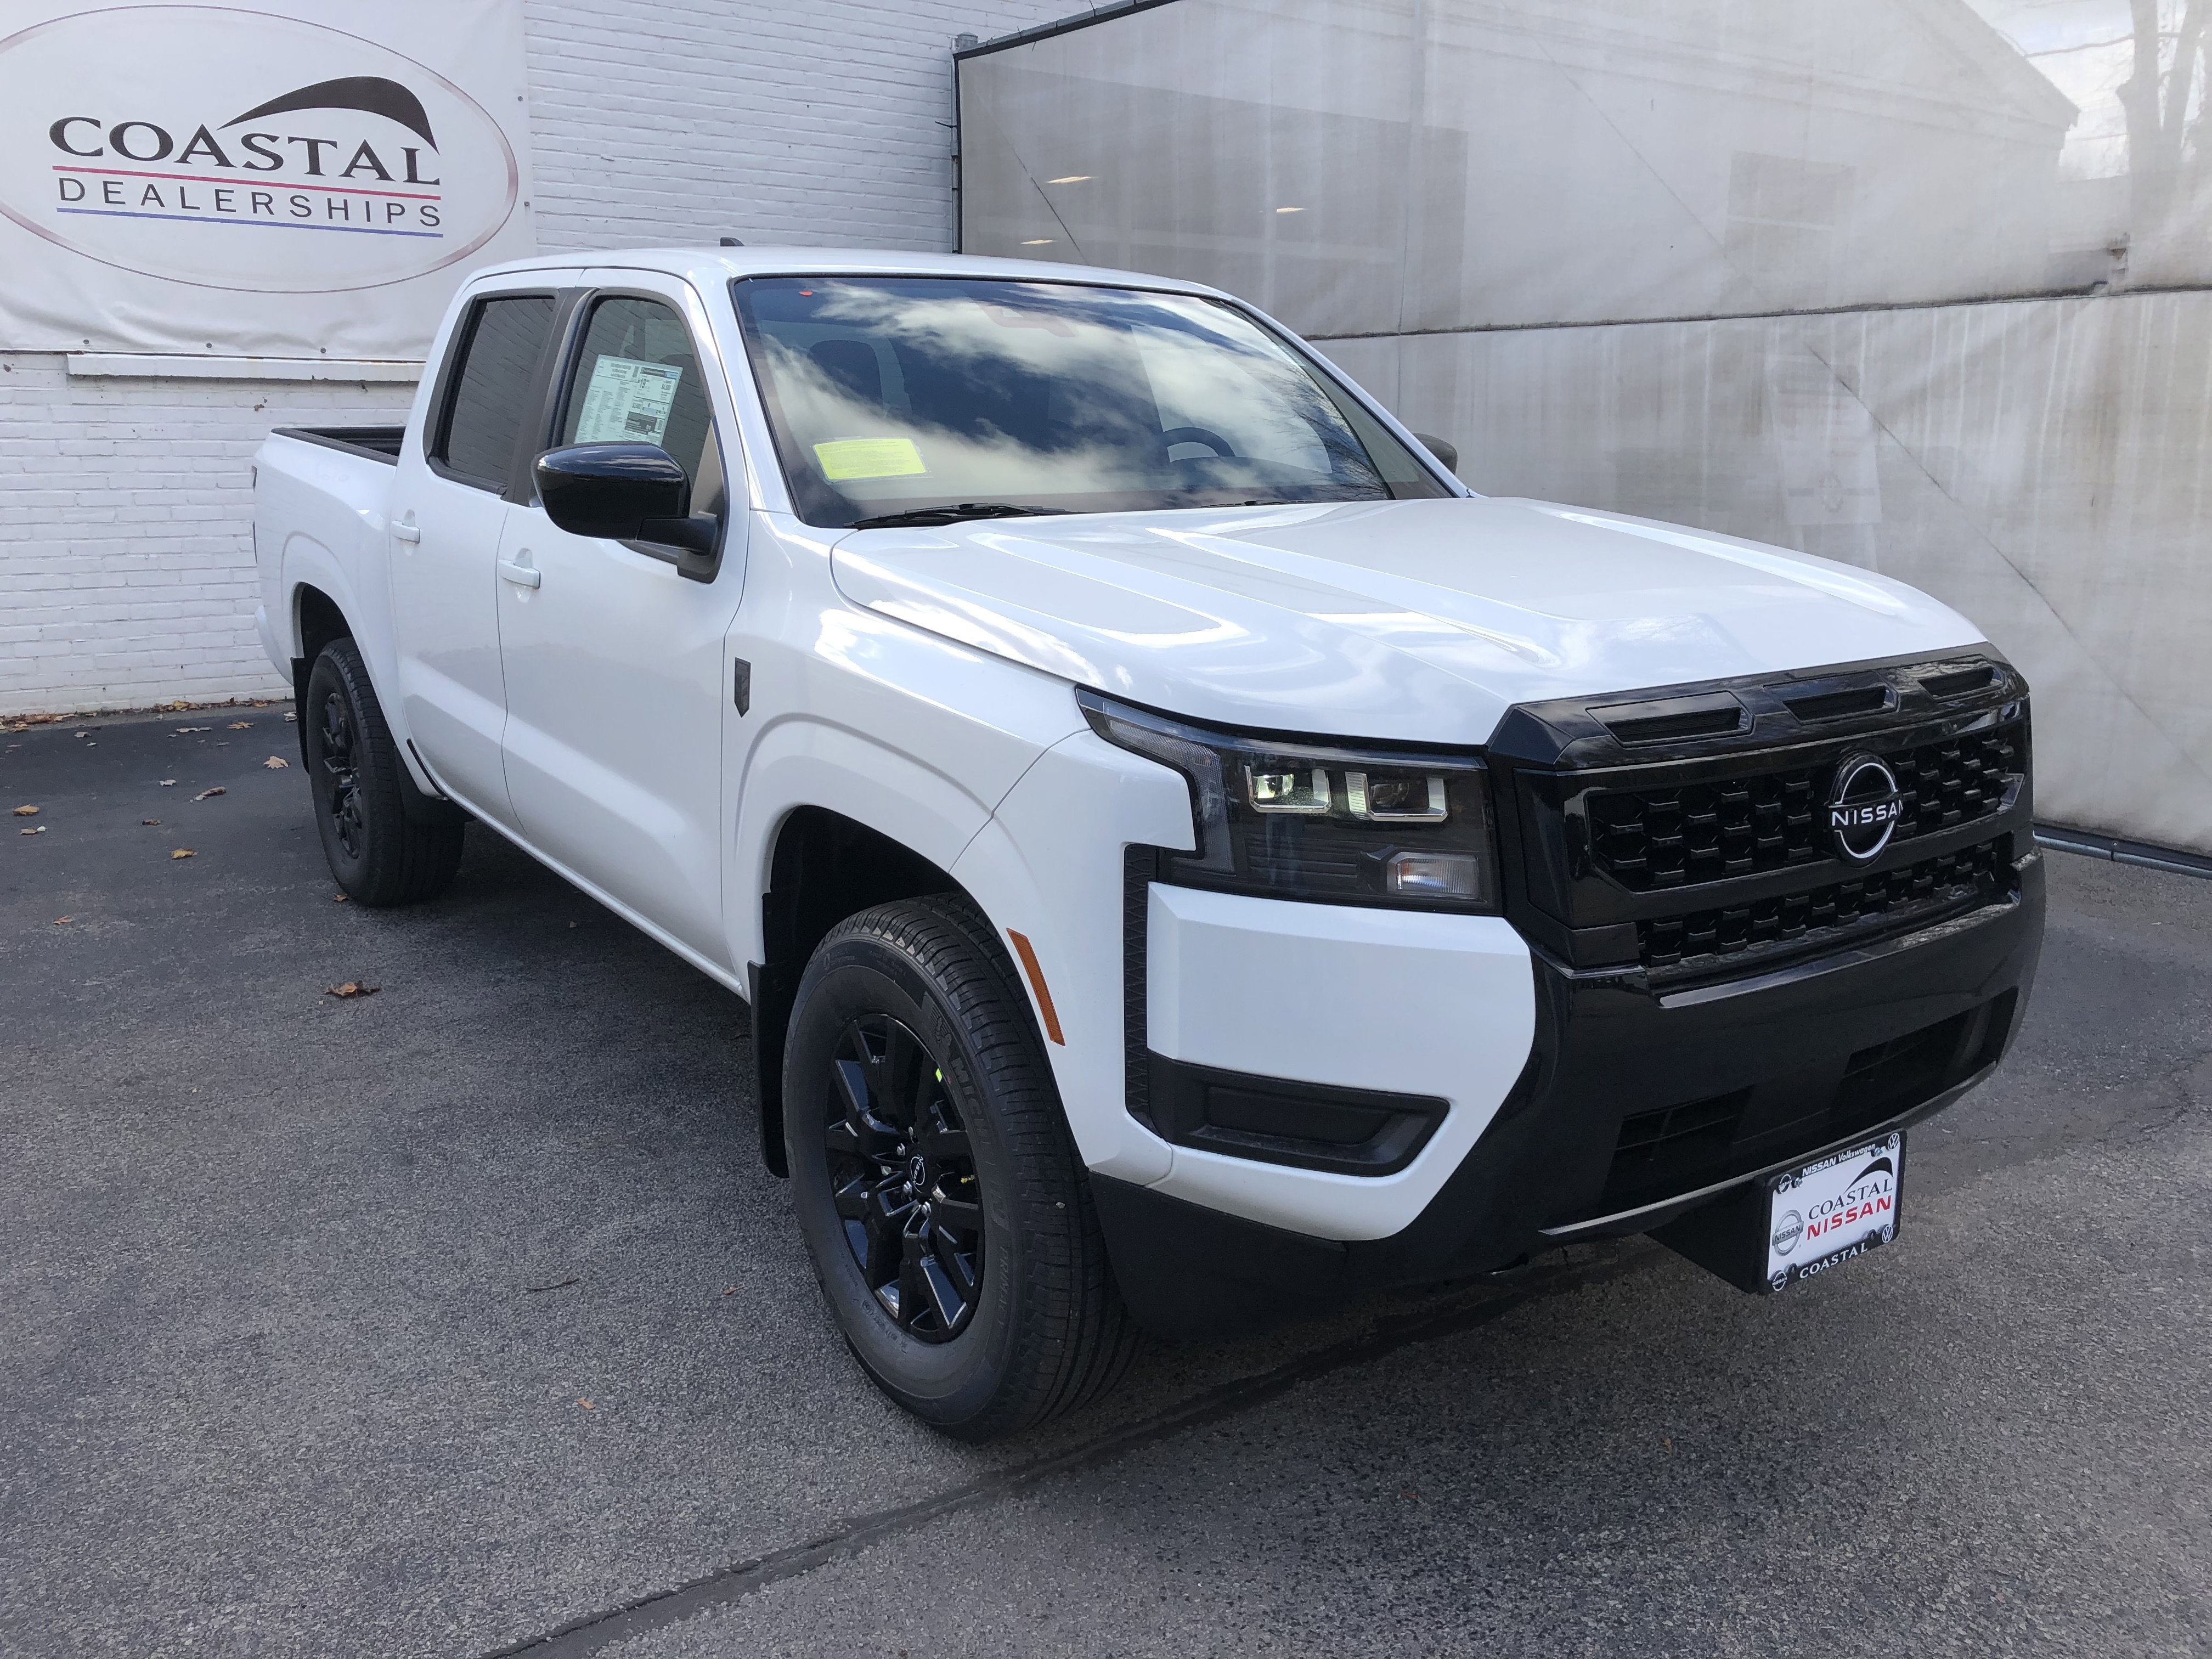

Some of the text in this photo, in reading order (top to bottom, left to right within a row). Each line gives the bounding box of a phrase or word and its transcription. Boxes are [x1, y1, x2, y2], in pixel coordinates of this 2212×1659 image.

[48, 115, 441, 186] COASTAL
[59, 177, 441, 227] DEALERSHIPS
[1831, 799, 1904, 826] NISSAN
[913, 1156, 924, 1185] NISSAN
[1802, 1143, 1876, 1177] NISSAN Volkswagen
[1807, 1195, 1892, 1240] NISSAN
[1808, 1178, 1893, 1220] COASTAL
[1774, 1224, 1801, 1242] NISSAN
[1799, 1242, 1868, 1279] COASTAL
